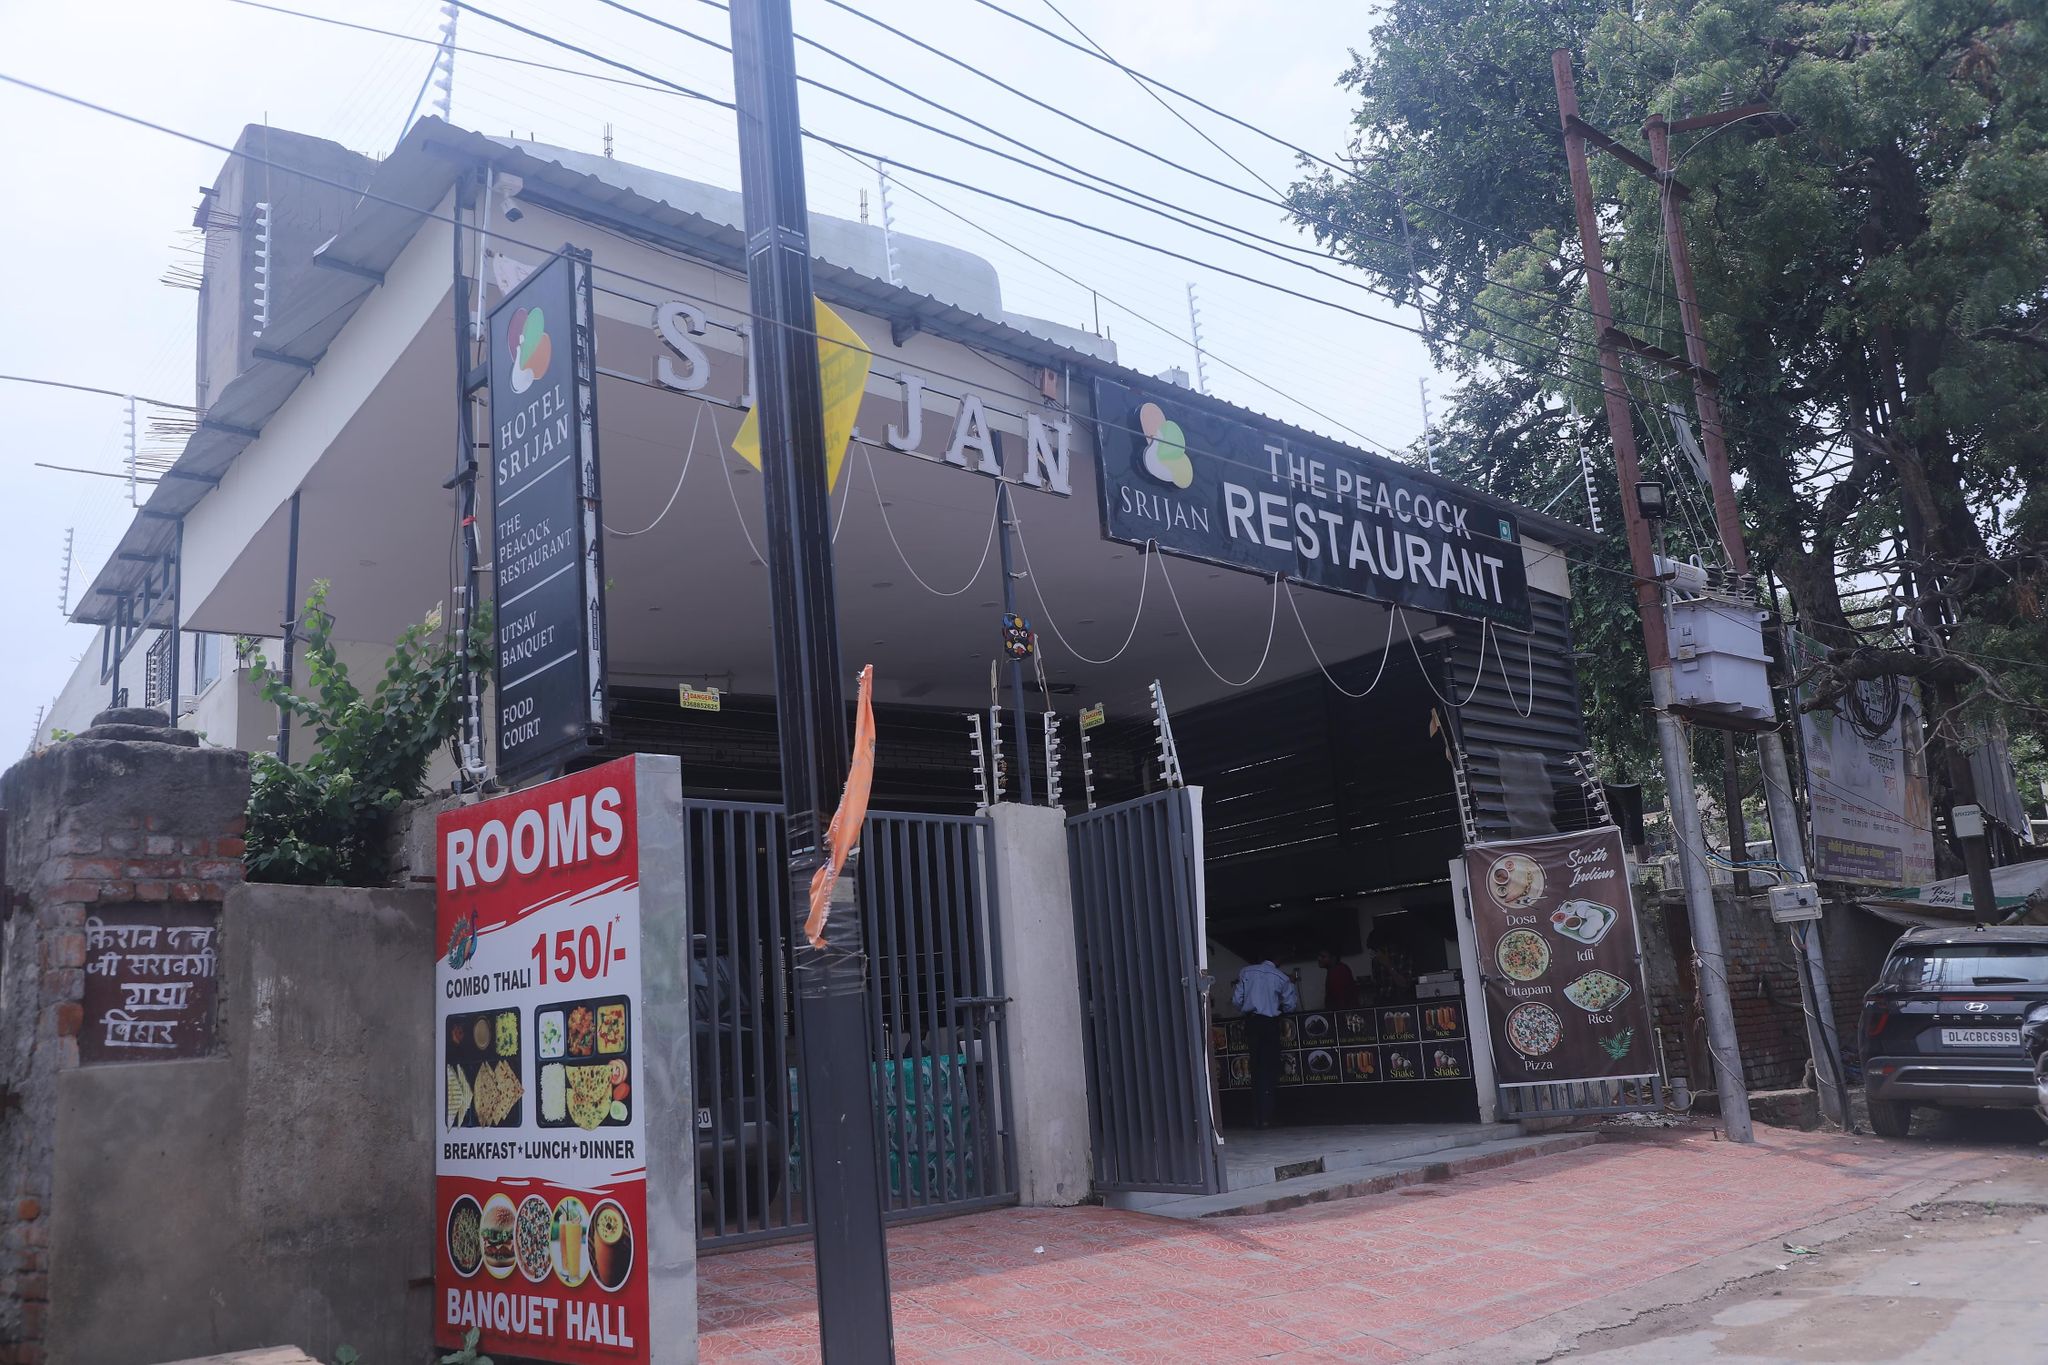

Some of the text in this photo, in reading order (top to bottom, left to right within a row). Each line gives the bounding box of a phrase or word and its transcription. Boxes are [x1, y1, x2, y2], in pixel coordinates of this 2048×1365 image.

[651, 299, 1074, 497] SJAN
[500, 384, 566, 450] HOTEL
[499, 413, 569, 486] SRIJAN
[1263, 443, 1471, 541] THE PEACOCK
[1120, 484, 1209, 534] SRIJAN
[498, 513, 521, 540] THE
[499, 518, 551, 564] PEACOCK
[500, 528, 572, 587] RESTAURANT
[1223, 481, 1504, 604] RESTAURANT
[501, 611, 537, 645] UTSAV
[502, 625, 555, 669] BANQUET
[502, 696, 534, 726] FOOD
[502, 717, 541, 751] COURT
[446, 786, 625, 892] ROOMS
[1565, 847, 1608, 869] South
[1568, 867, 1616, 888] Indian
[1506, 914, 1537, 926] Dosa
[87, 951, 123, 976] जी
[1576, 949, 1595, 962] Idli
[446, 975, 490, 998] COMBO
[493, 967, 532, 991] THALI
[1504, 984, 1552, 998] Uttapam
[1588, 1013, 1613, 1026] Rice
[1948, 1031, 2018, 1042] DL4CBC6969
[1390, 1068, 1415, 1079] Shake
[1433, 1067, 1460, 1077] Shake
[1524, 1060, 1553, 1072] Pizza
[443, 1140, 635, 1161] BREAKFAST LUNCH DINNER
[446, 1287, 634, 1347] BANQUET HALL
